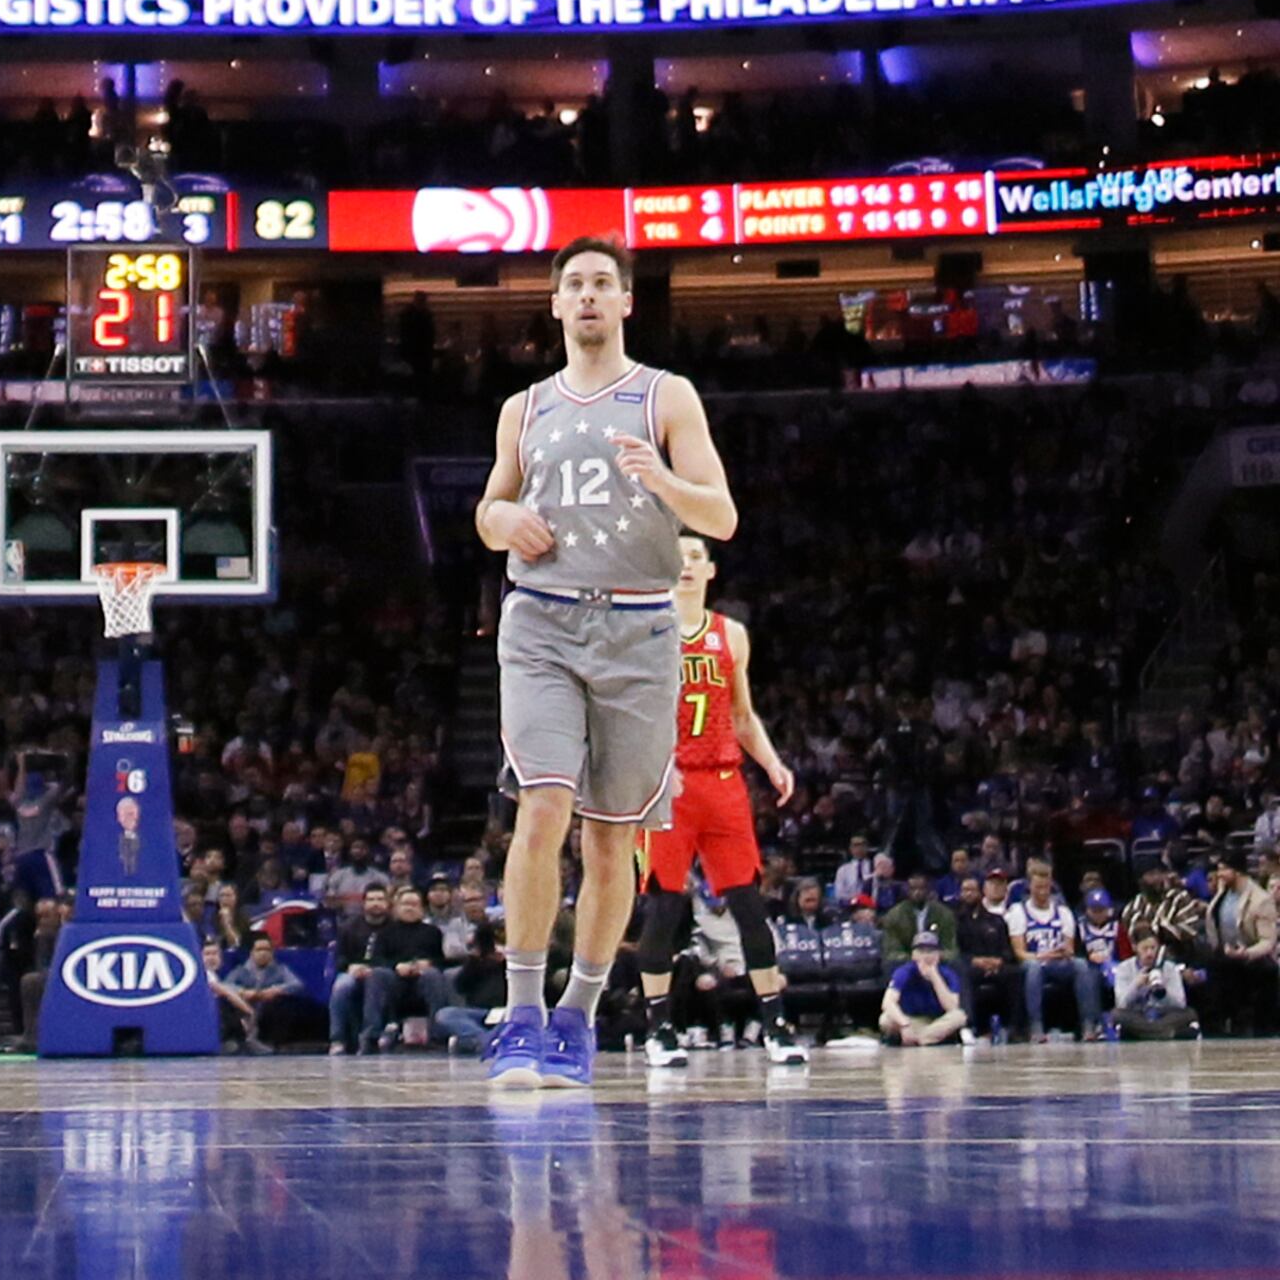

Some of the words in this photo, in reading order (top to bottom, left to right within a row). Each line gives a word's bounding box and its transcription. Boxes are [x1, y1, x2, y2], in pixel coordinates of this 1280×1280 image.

[700, 189, 723, 215] 3
[739, 186, 826, 212] PLAYER
[929, 180, 946, 203] 7
[50, 200, 154, 242] 2:58
[183, 213, 210, 244] 3
[255, 199, 316, 240] 82
[699, 215, 725, 241] 4
[743, 213, 826, 236] POINTS
[105, 253, 182, 291] 2:58
[93, 289, 173, 348] 21
[106, 356, 187, 374] TISSOT
[559, 456, 611, 507] 12
[684, 693, 708, 737] 7
[85, 951, 175, 990] KIA
